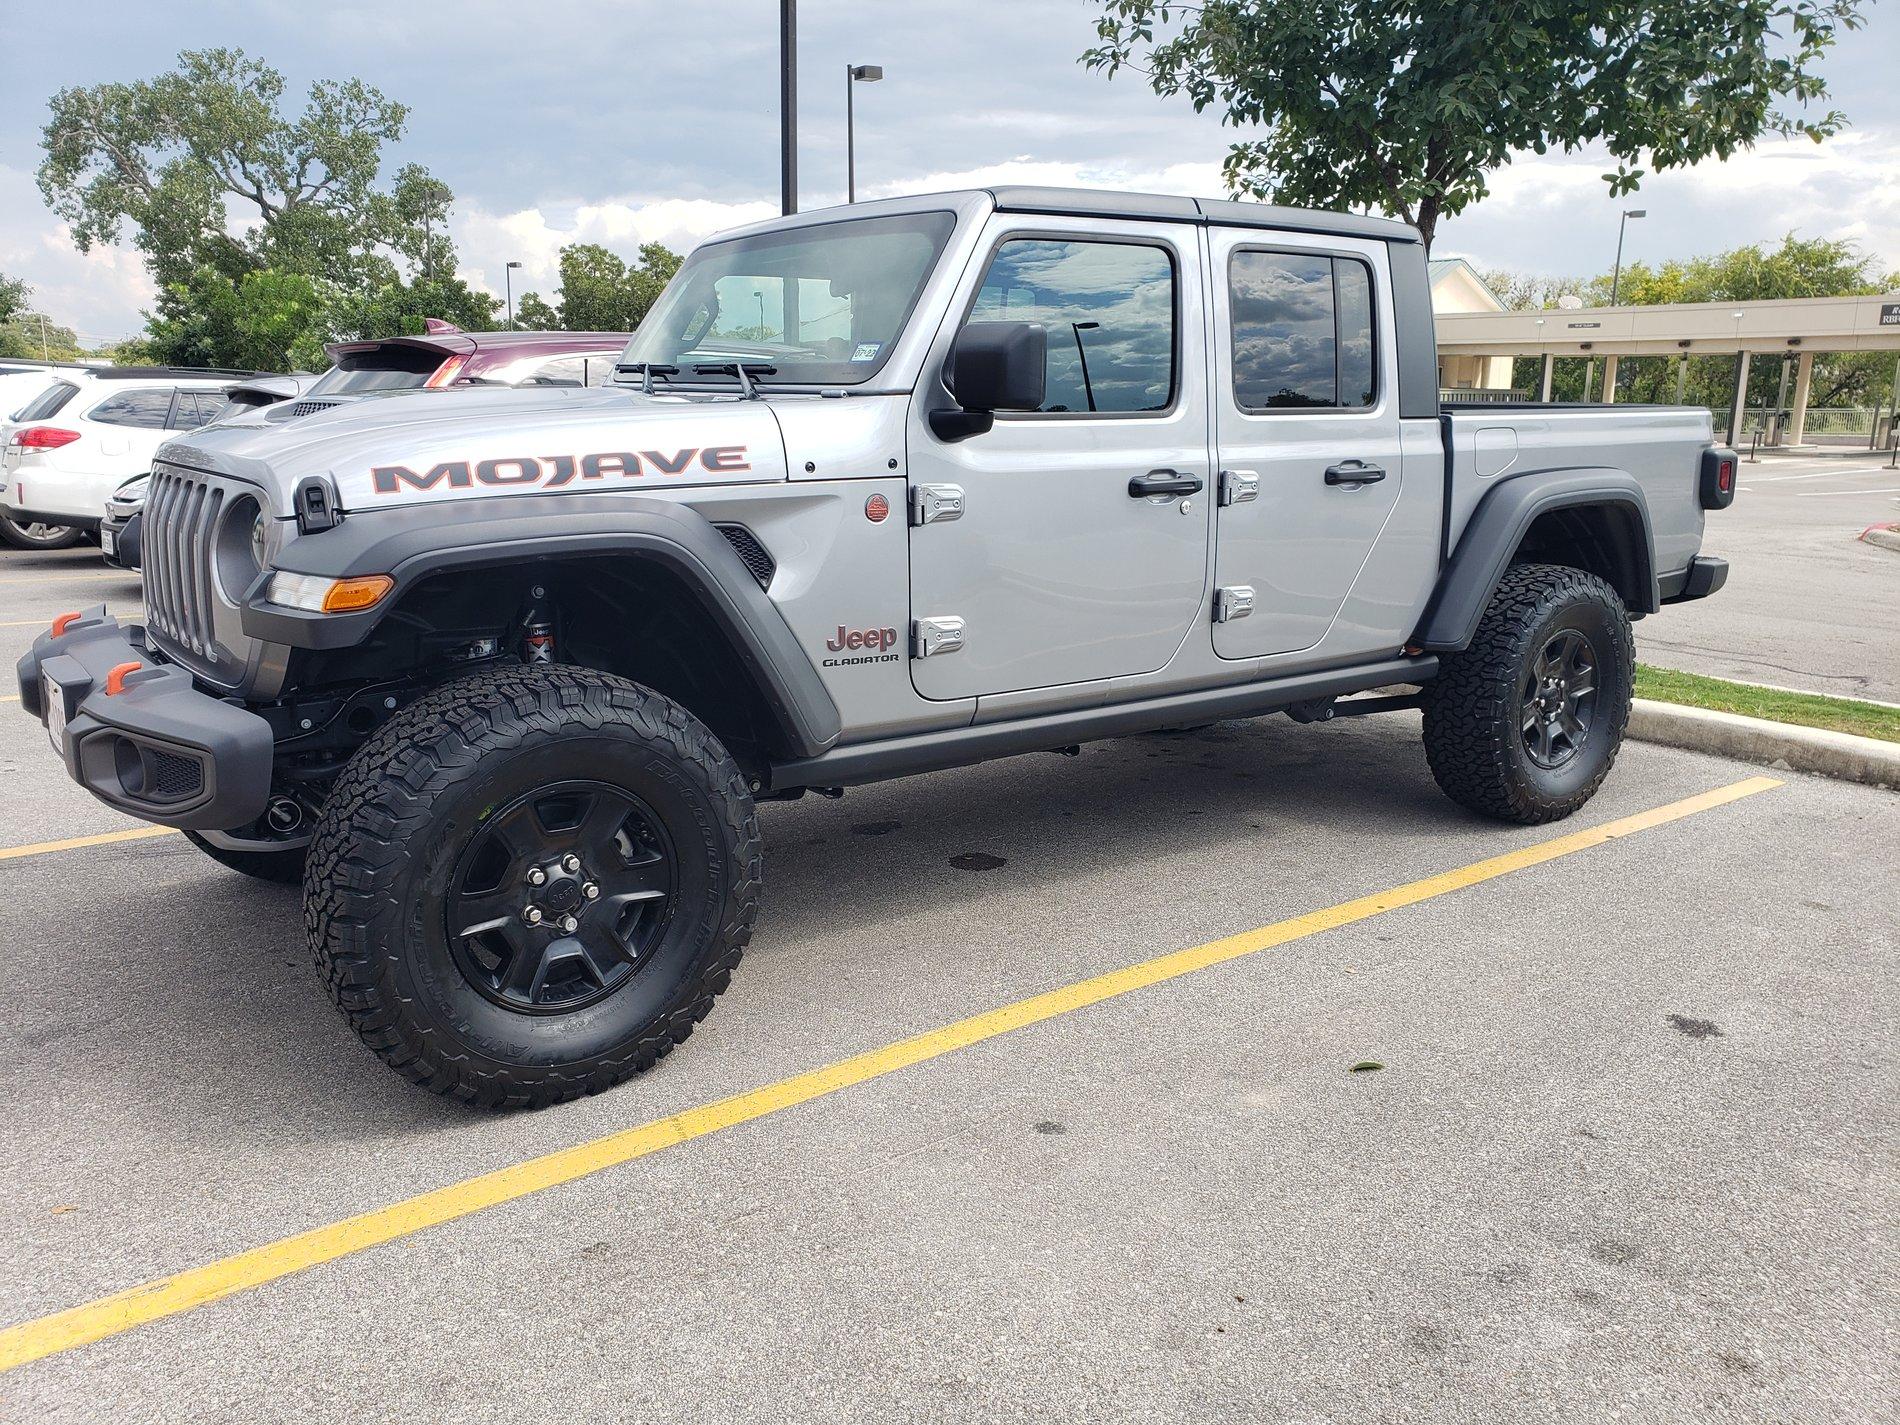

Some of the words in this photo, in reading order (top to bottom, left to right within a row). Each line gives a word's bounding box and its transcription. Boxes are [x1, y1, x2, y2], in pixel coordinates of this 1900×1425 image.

[1883, 315, 1900, 324] RBF
[371, 445, 752, 494] MOJAVE
[826, 624, 897, 652] Jeep
[822, 654, 899, 667] GLADIATOR
